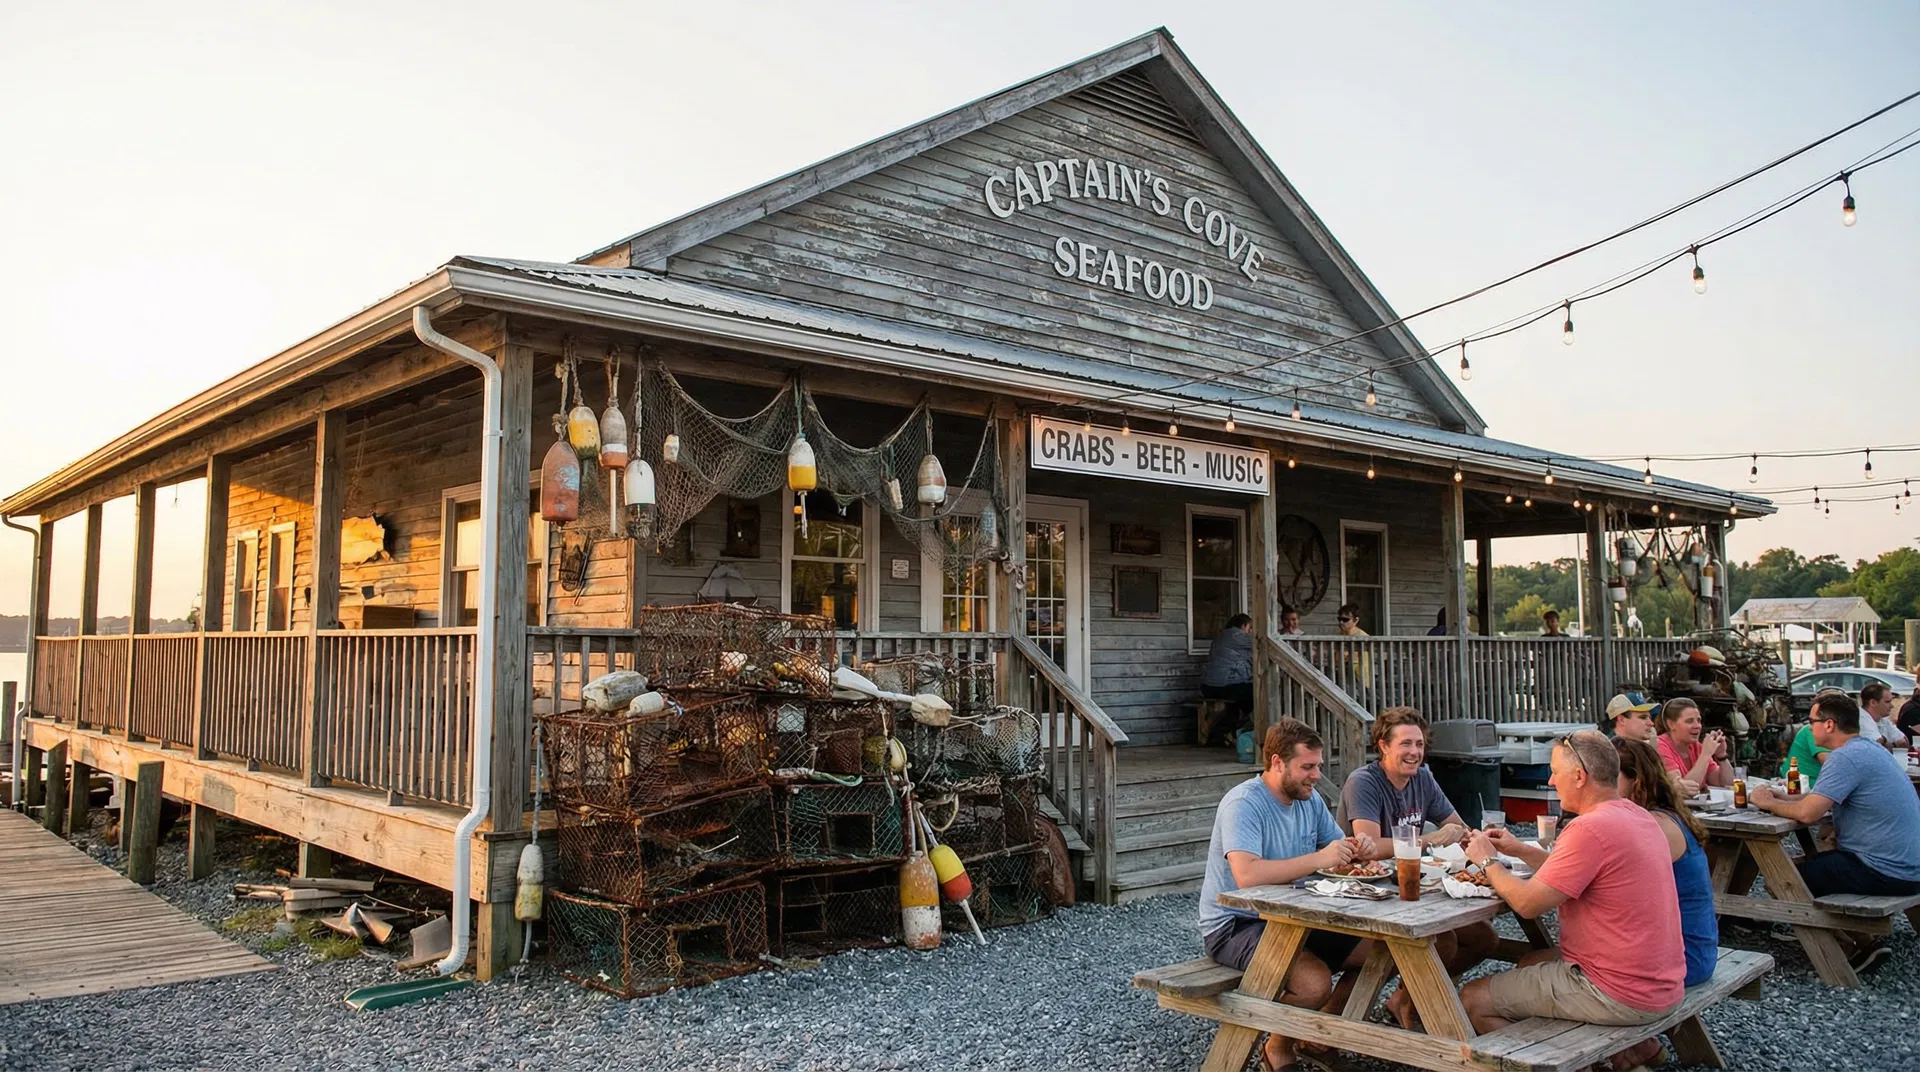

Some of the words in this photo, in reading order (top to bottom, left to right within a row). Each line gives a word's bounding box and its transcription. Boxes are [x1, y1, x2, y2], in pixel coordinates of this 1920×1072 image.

[985, 158, 1171, 218] CAPTAIN'S
[1183, 196, 1265, 283] COVE
[1054, 236, 1214, 311] SEAFOOD
[1041, 427, 1115, 466] CRABS
[1136, 441, 1186, 475] BEER
[1206, 451, 1264, 485] MUSIC
